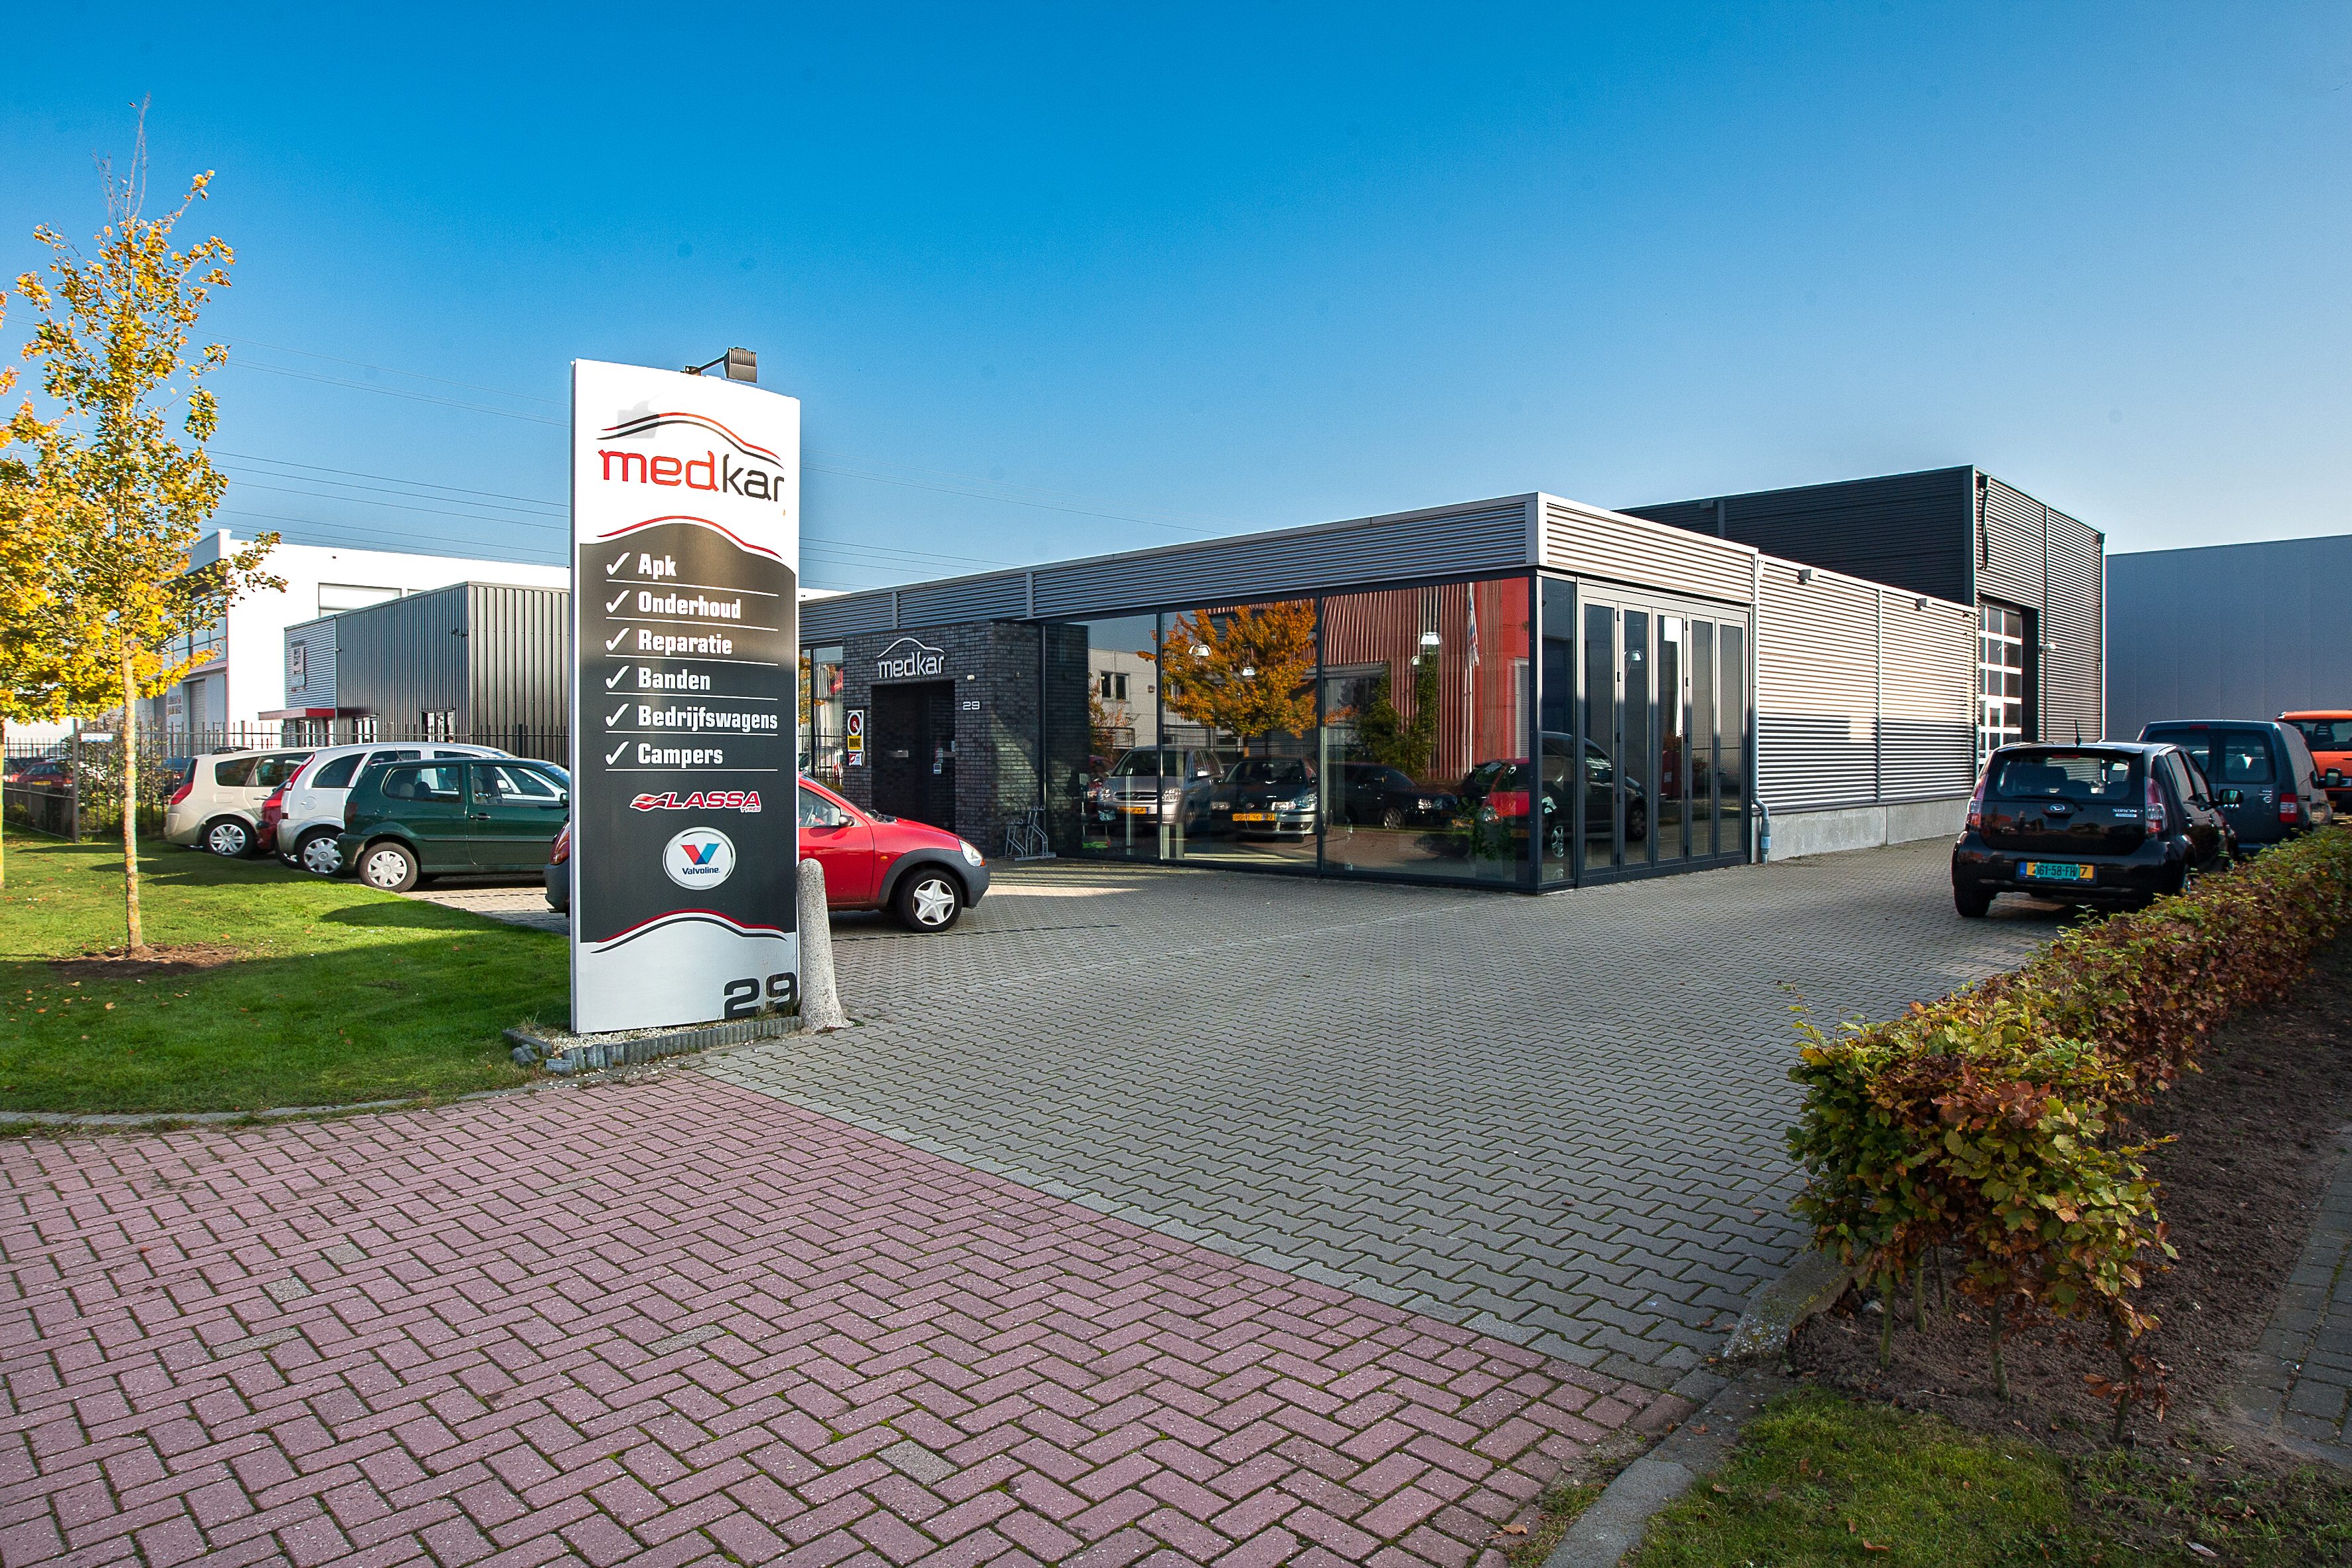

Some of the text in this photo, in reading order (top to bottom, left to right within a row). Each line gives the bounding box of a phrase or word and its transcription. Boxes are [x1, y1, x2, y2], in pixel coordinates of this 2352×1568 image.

[597, 449, 785, 502] medkar
[638, 553, 677, 580] Apk
[638, 591, 742, 619] Onderhoud
[638, 629, 733, 656] Reparatie
[877, 651, 945, 678] medkar
[638, 667, 711, 690] Banden
[638, 705, 778, 732] Bedrijfswagens
[963, 700, 980, 710] 29
[638, 743, 724, 769] Campers
[666, 792, 761, 808] LASSA
[724, 971, 797, 1019] 29
